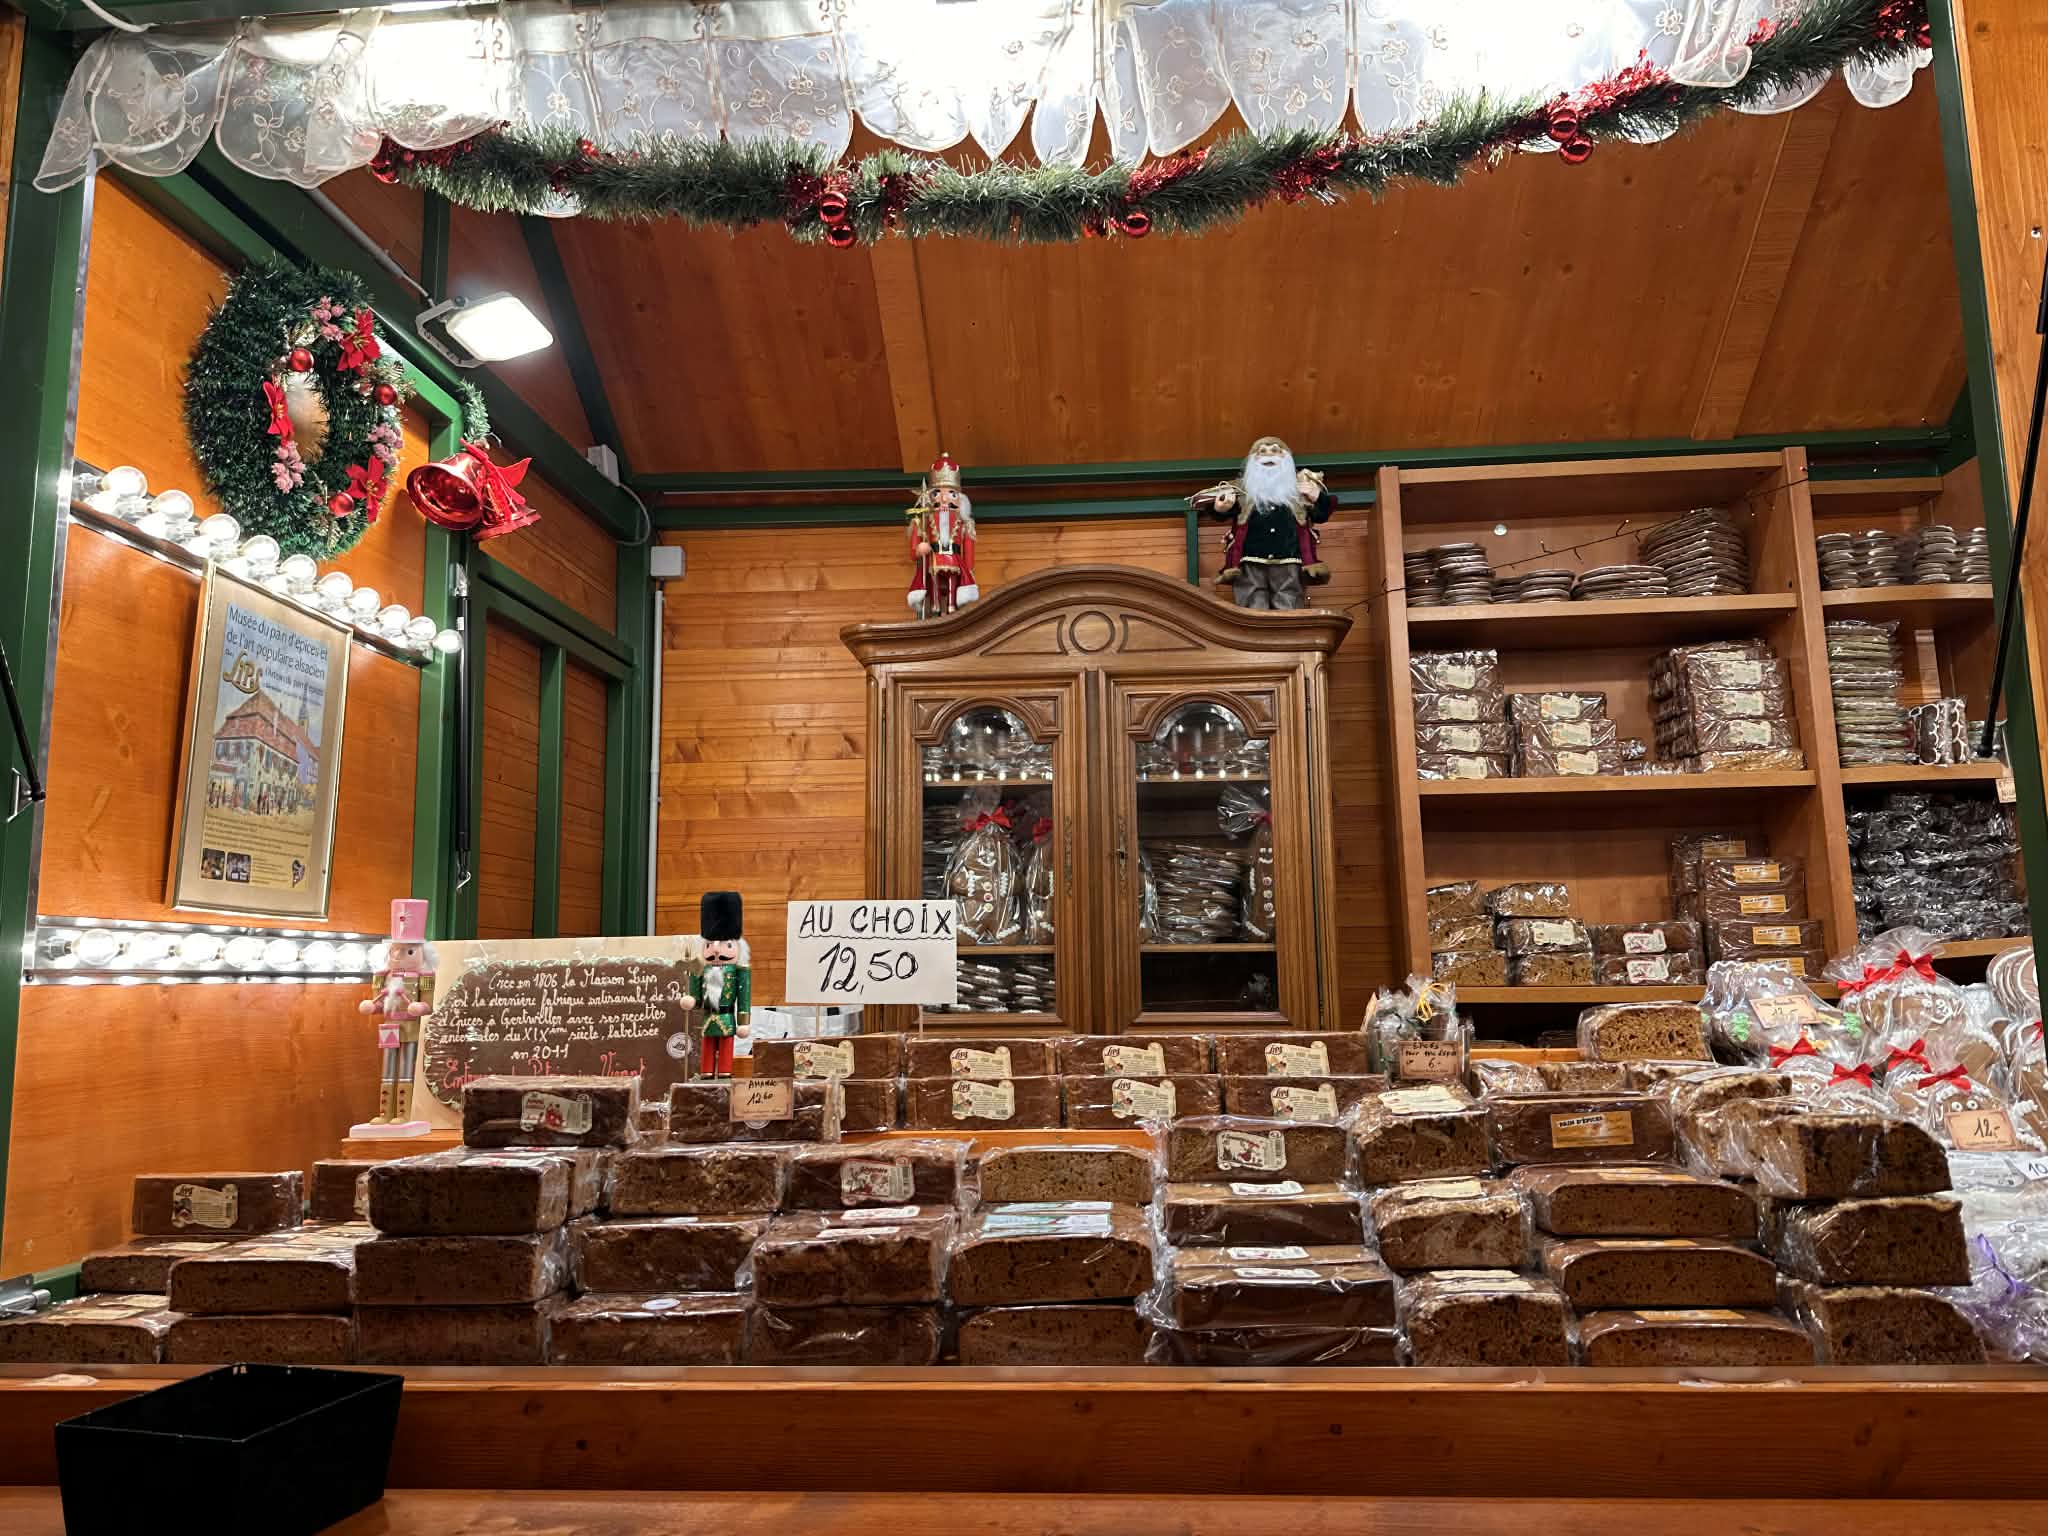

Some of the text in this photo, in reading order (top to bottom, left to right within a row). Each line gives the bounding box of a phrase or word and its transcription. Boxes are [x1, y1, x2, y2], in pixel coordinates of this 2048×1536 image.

[256, 644, 294, 668] populaire
[294, 658, 325, 680] alsacien
[799, 904, 834, 935] AU
[516, 978, 530, 988] en
[533, 973, 558, 988] 1806
[561, 967, 576, 988] la
[579, 967, 625, 988] Maison
[818, 942, 919, 995] 12,50
[472, 986, 486, 1007] la
[539, 988, 584, 1018] fabrique
[588, 986, 646, 1005] artisanale
[649, 987, 664, 1002] de
[501, 1006, 562, 1029] Gertwiller
[566, 1015, 595, 1024] avec
[599, 1013, 619, 1024] ses
[620, 1003, 666, 1022] recettes
[503, 1026, 521, 1041] du
[532, 1043, 569, 1059] 2011
